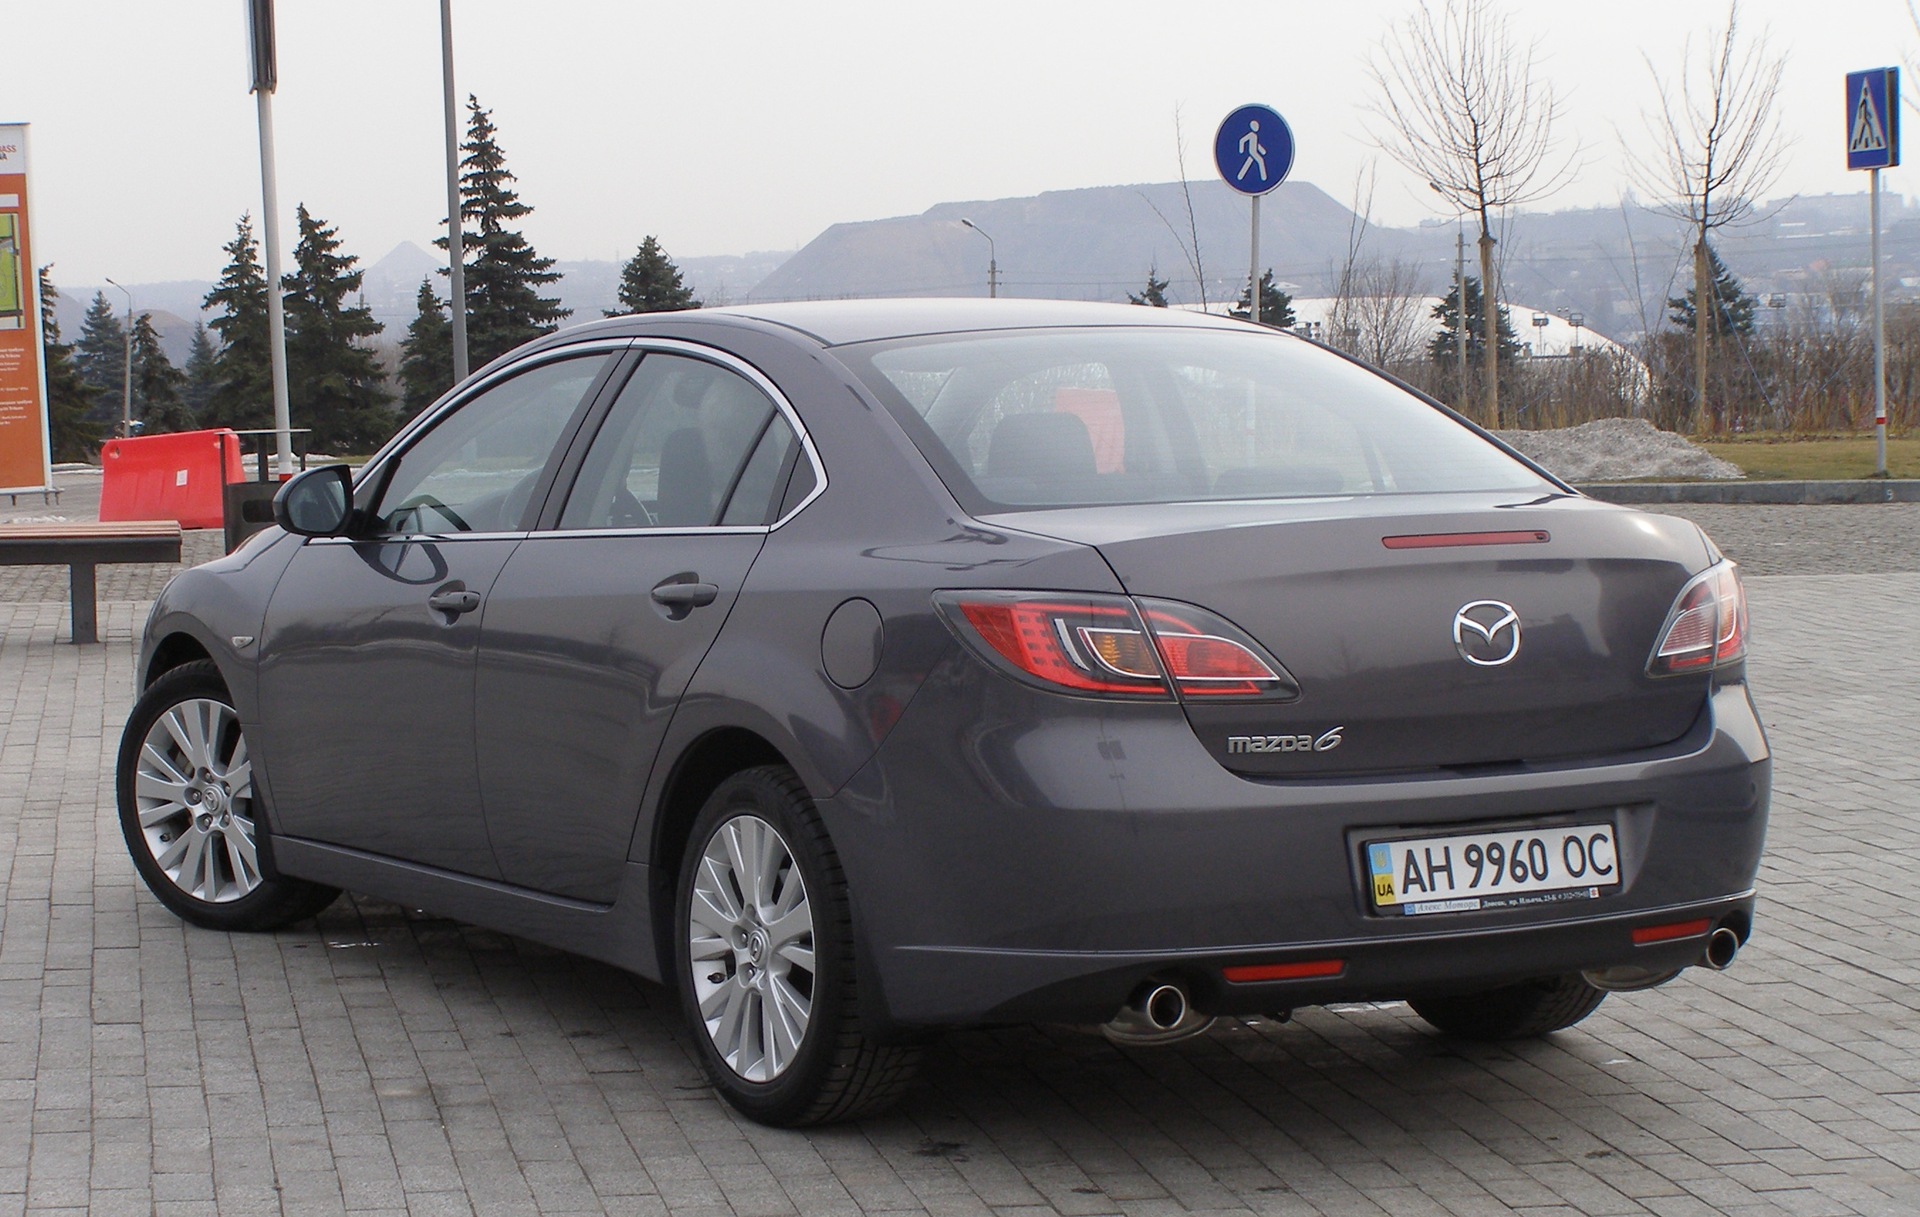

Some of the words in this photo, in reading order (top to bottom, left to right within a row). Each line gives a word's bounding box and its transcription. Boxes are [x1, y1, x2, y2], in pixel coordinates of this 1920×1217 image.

[1402, 845, 1455, 894] AH
[1464, 837, 1547, 888] 9960
[1562, 833, 1613, 878] OC
[1378, 883, 1394, 896] UA
[1417, 903, 1442, 912] Алекс
[1444, 900, 1478, 910] Моторс
